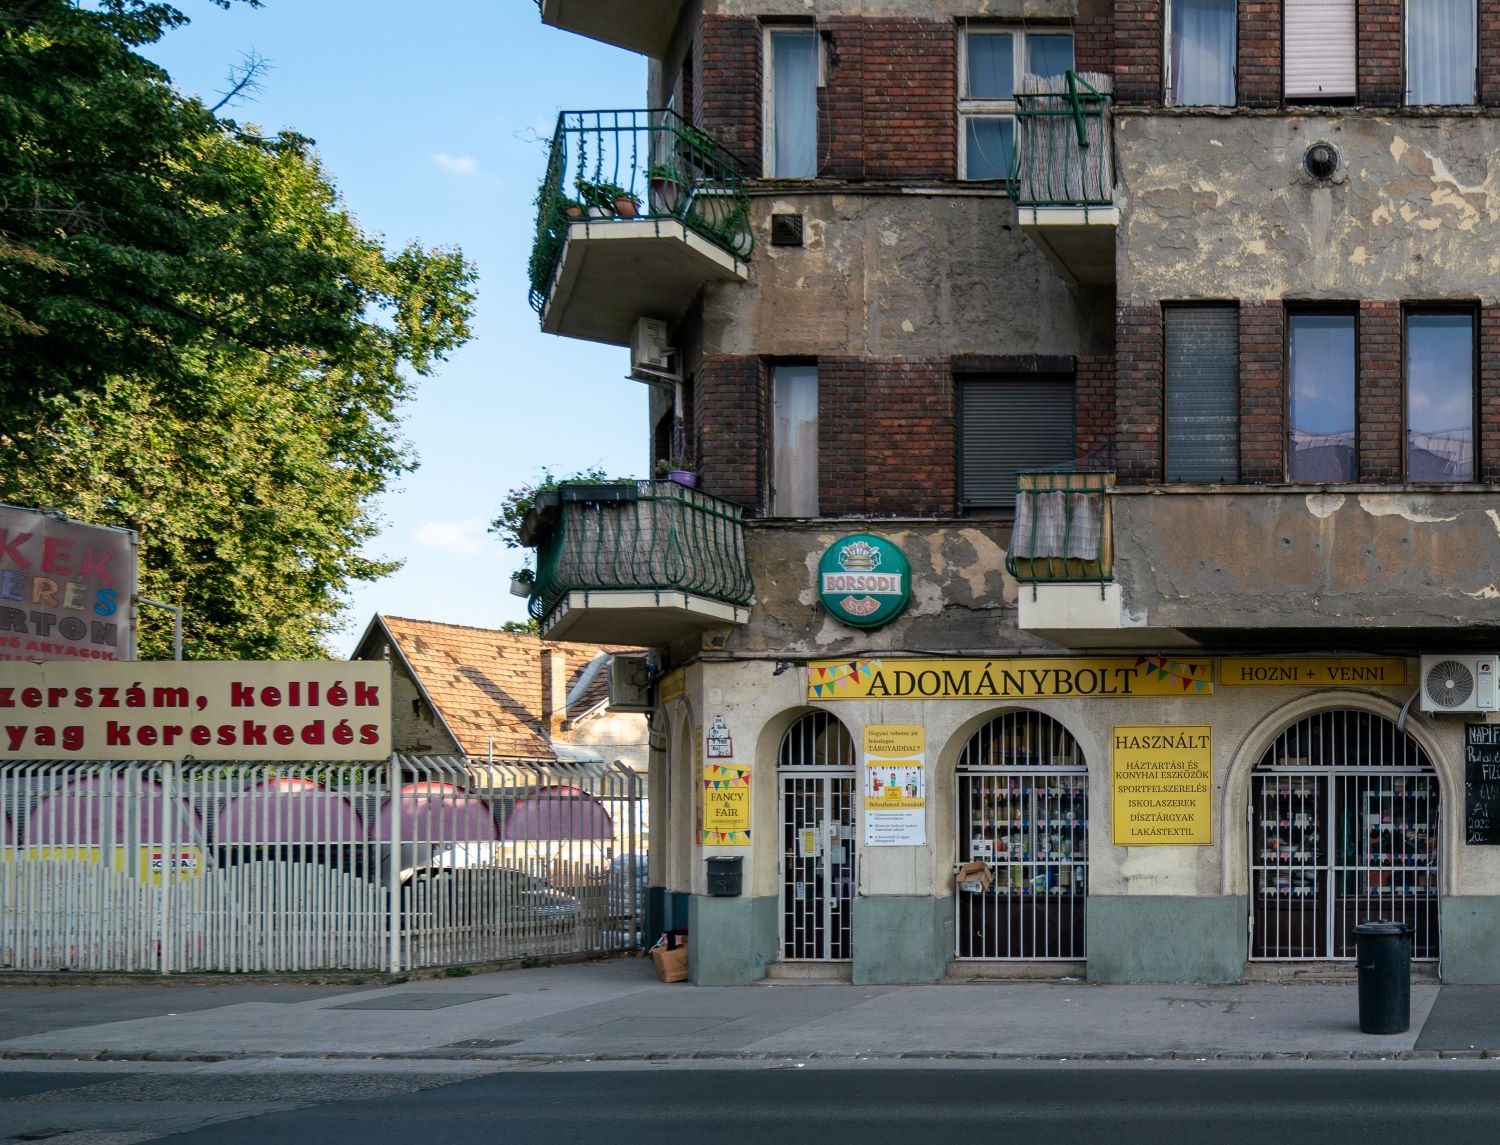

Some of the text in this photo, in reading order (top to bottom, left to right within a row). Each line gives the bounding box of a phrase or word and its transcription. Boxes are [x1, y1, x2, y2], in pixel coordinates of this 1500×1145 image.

[826, 575, 897, 592] BORSODI
[866, 662, 1138, 696] ADOMÁNYBOLT
[1241, 667, 1385, 681] HOZNI + VENNI
[0, 681, 380, 711] zerszám, kellék
[5, 719, 380, 751] yag kereskedés
[1116, 732, 1209, 749] HASZNÁLT
[1126, 760, 1199, 770] HÁZTARTÁSI ÉS
[1116, 771, 1158, 779] KONYHAI
[1118, 784, 1208, 793] SPORTFELSZERELÉS
[710, 793, 744, 802] FANCY
[723, 801, 731, 809] &
[1128, 799, 1197, 807] ISKOLASZEREK
[715, 808, 738, 817] FAIR
[1130, 812, 1195, 822] DÍSZTÁRGYAK
[1131, 826, 1194, 836] LAKÁSTEXTIL
